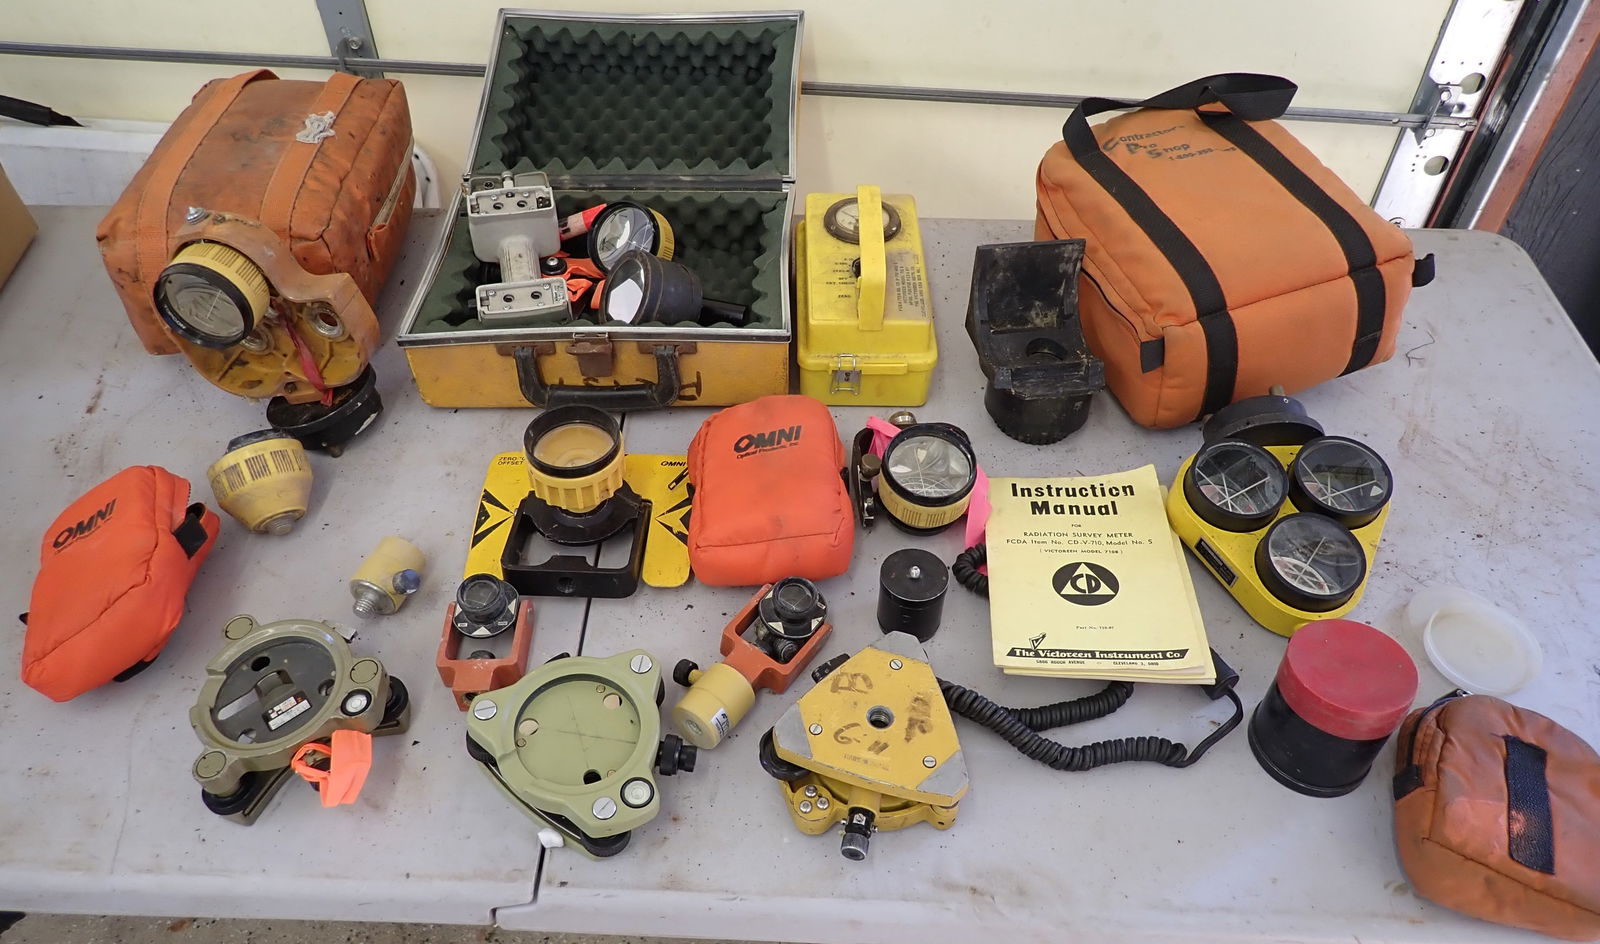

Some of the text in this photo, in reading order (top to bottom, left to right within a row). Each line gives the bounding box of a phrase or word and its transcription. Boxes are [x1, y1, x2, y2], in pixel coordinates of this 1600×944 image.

[1126, 142, 1158, 155] Pro
[1146, 143, 1190, 159] Shop
[733, 425, 802, 453] OMNI
[1011, 483, 1135, 498] Instruction
[1030, 500, 1119, 516] Manual
[52, 497, 117, 549] OMNI
[1070, 573, 1101, 594] CD
[1014, 648, 1036, 657] The
[1037, 649, 1092, 658] Victoreen
[1094, 651, 1164, 659] Instrument
